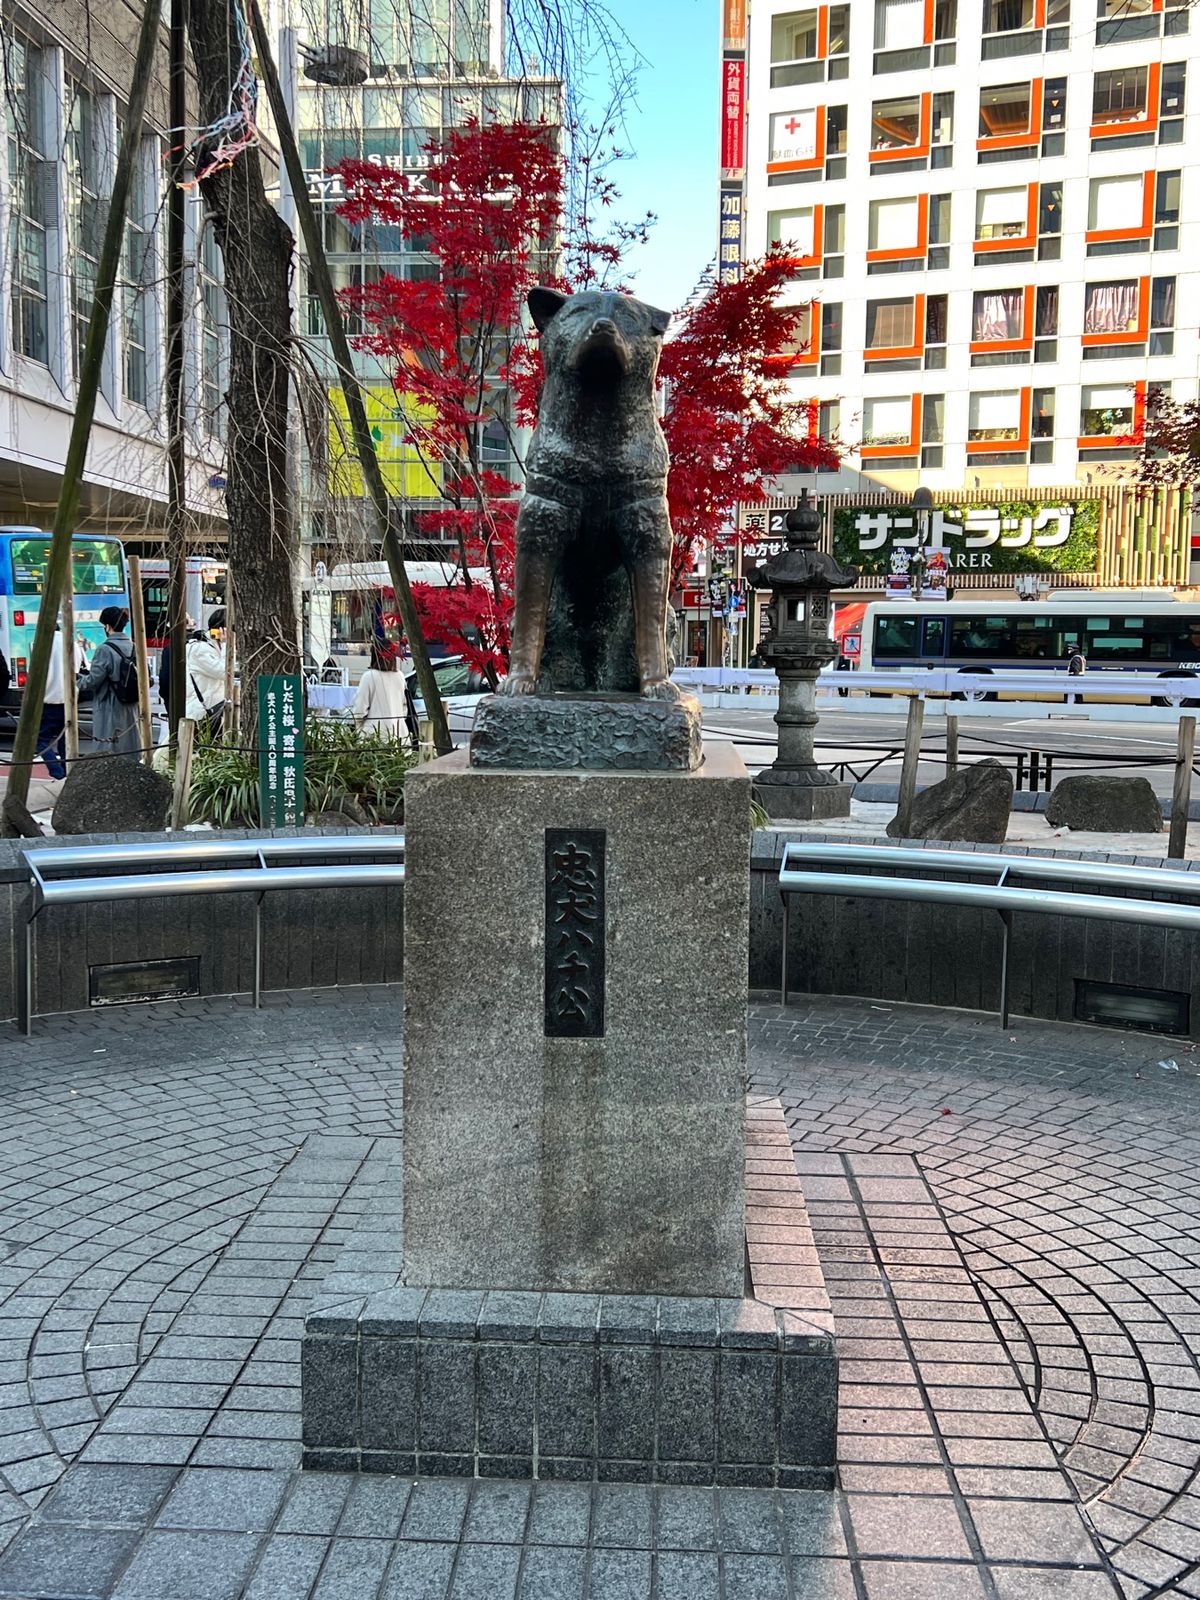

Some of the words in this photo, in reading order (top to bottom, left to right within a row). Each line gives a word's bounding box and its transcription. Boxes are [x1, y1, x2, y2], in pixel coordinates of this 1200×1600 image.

[727, 62, 741, 119] 外貨両替
[721, 195, 740, 287] 加藤眼科
[746, 514, 768, 537] 薬
[854, 507, 1074, 550] サンドラッグ
[282, 680, 295, 727] しだれ桜
[552, 842, 598, 1023] 忠犬ハチ公
